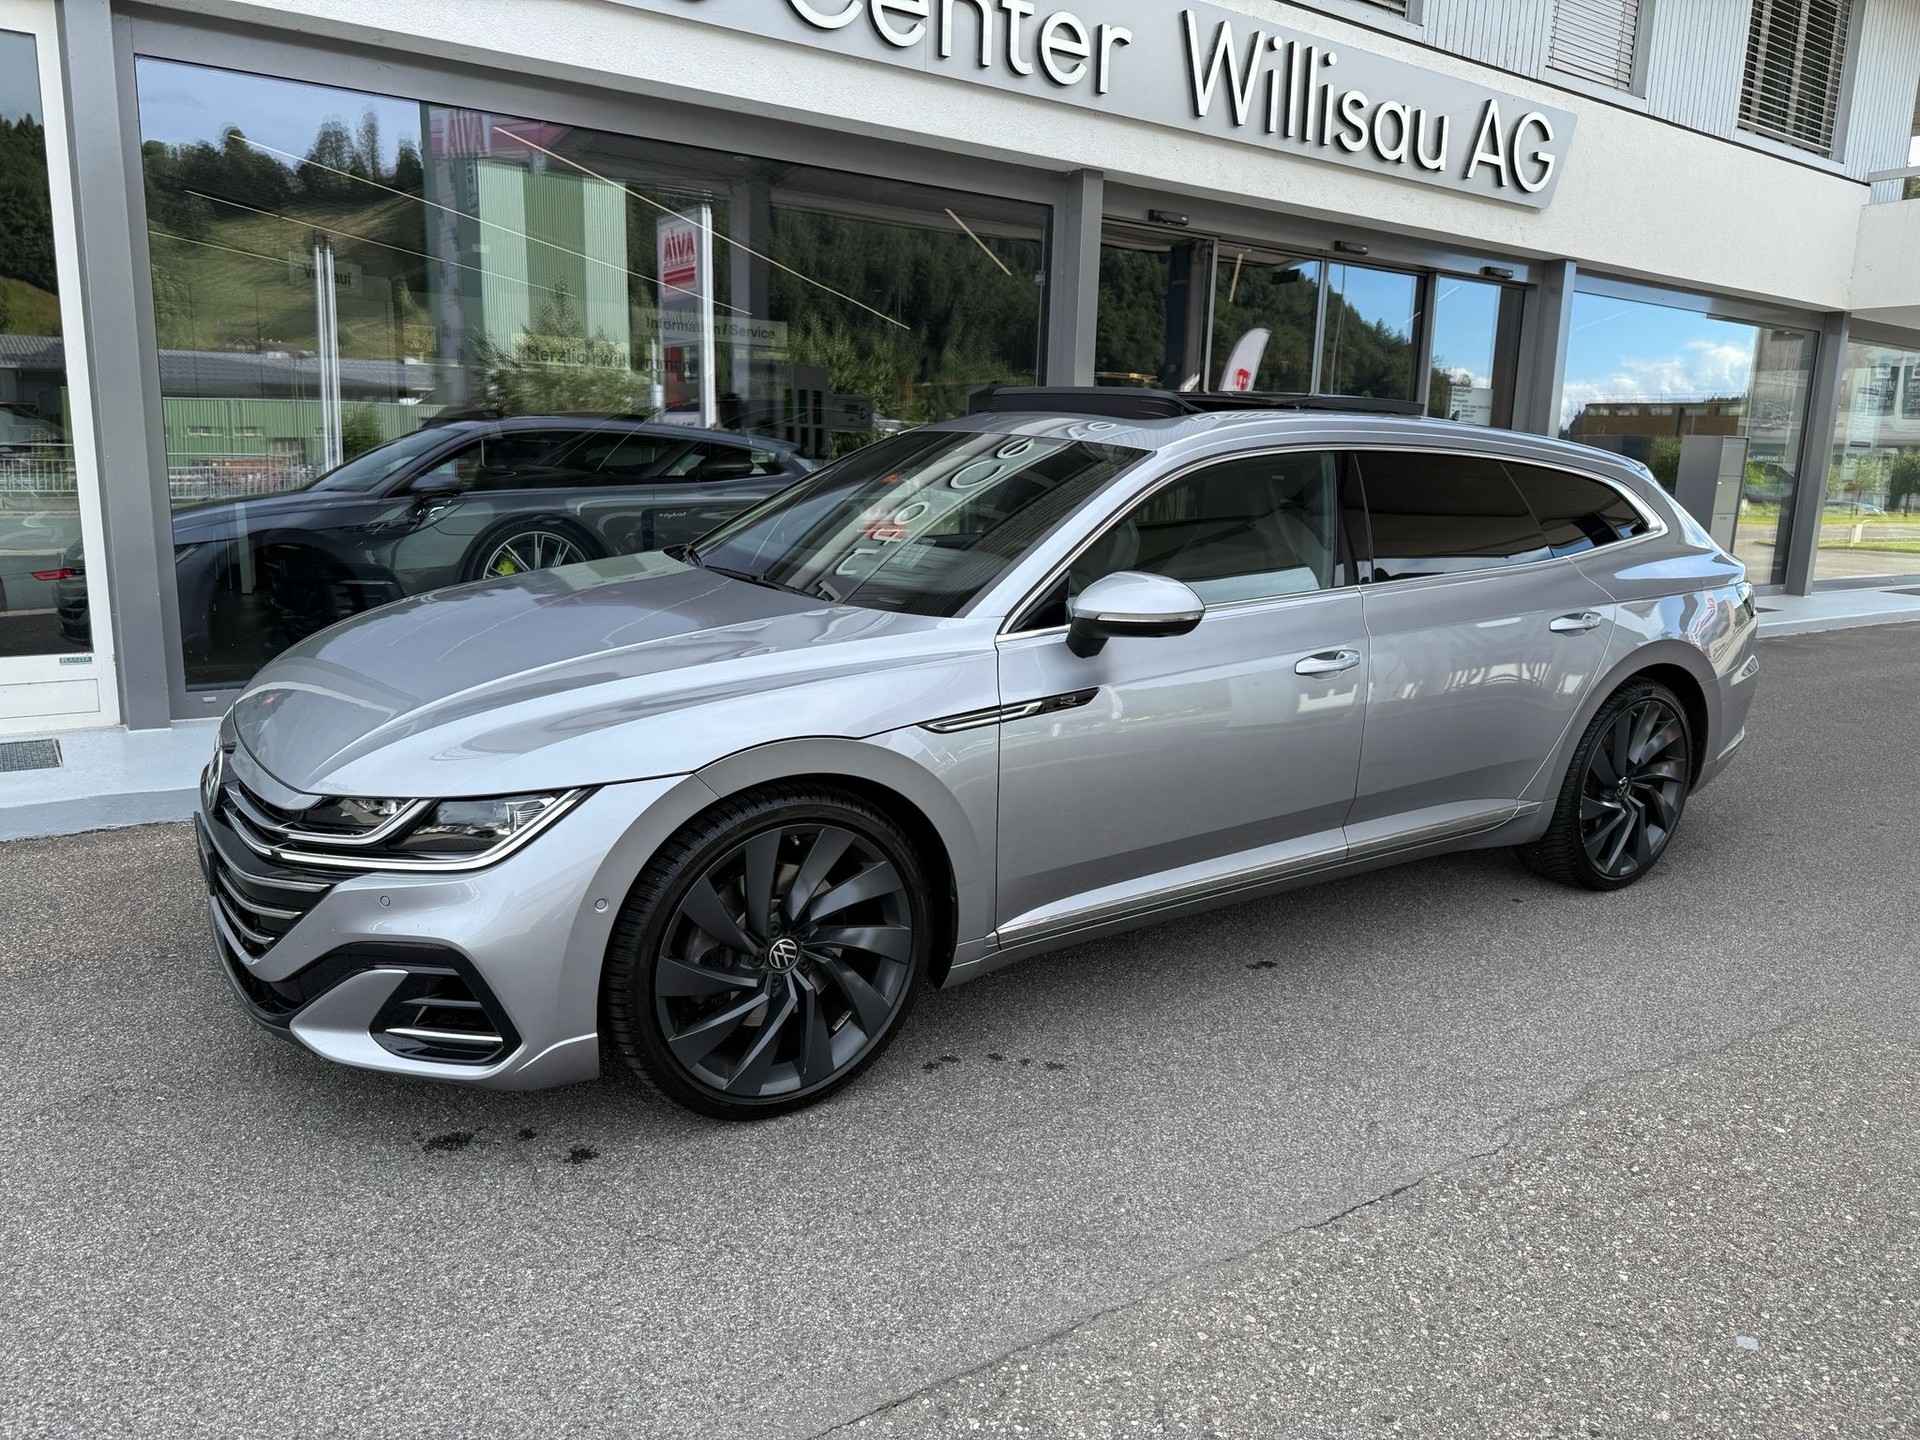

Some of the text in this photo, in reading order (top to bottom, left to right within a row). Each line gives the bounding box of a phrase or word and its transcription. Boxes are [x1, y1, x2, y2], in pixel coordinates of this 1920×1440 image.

[786, 0, 1556, 193] enter Willisau AG
[303, 262, 352, 286] Veauf
[647, 316, 719, 335] Informatn
[730, 323, 776, 340] Service
